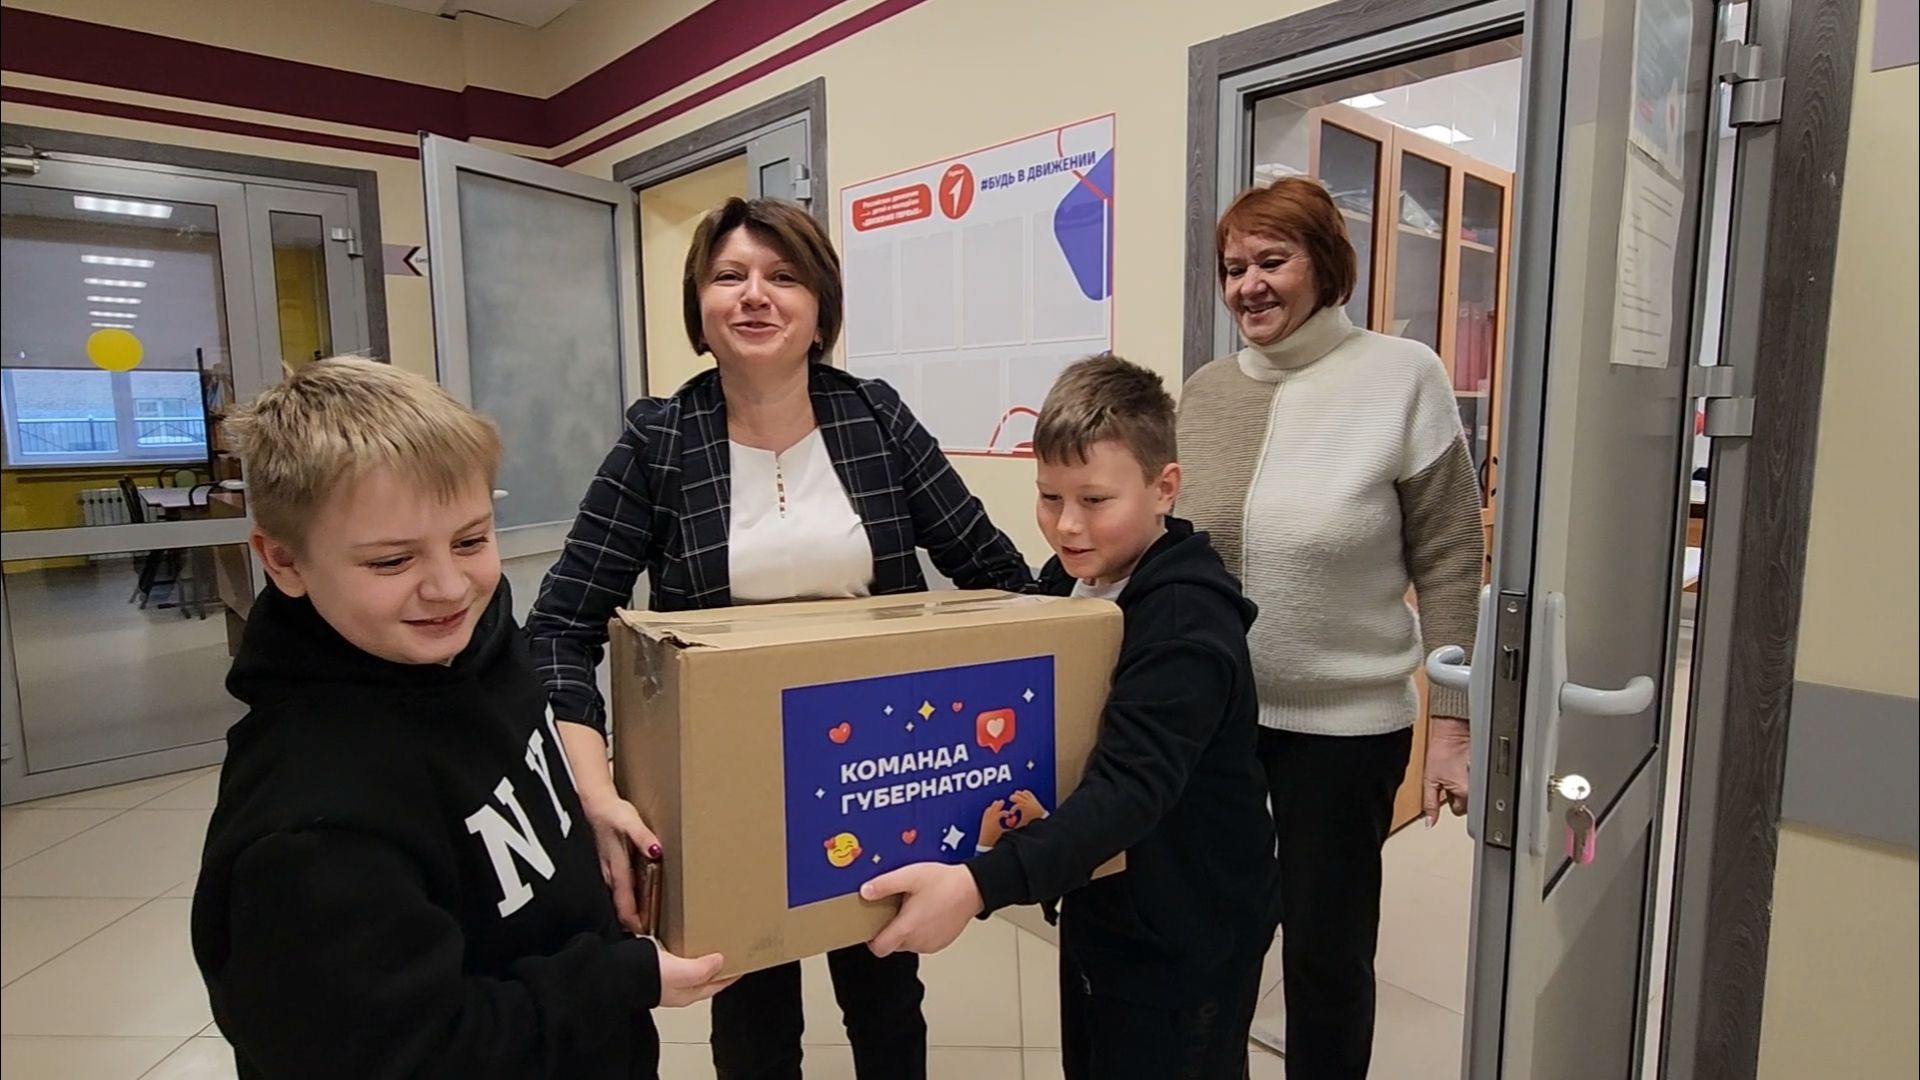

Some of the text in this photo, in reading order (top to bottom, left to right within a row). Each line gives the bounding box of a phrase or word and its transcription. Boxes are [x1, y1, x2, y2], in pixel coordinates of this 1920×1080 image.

[981, 172, 1015, 191] #БУДЬ
[1018, 169, 1025, 182] В
[1027, 150, 1096, 182] ДВИЖЕНИИ
[841, 743, 969, 784] КОМАНДА
[464, 702, 579, 918] NY
[841, 764, 1012, 814] ГУБЕРНАТОРА
